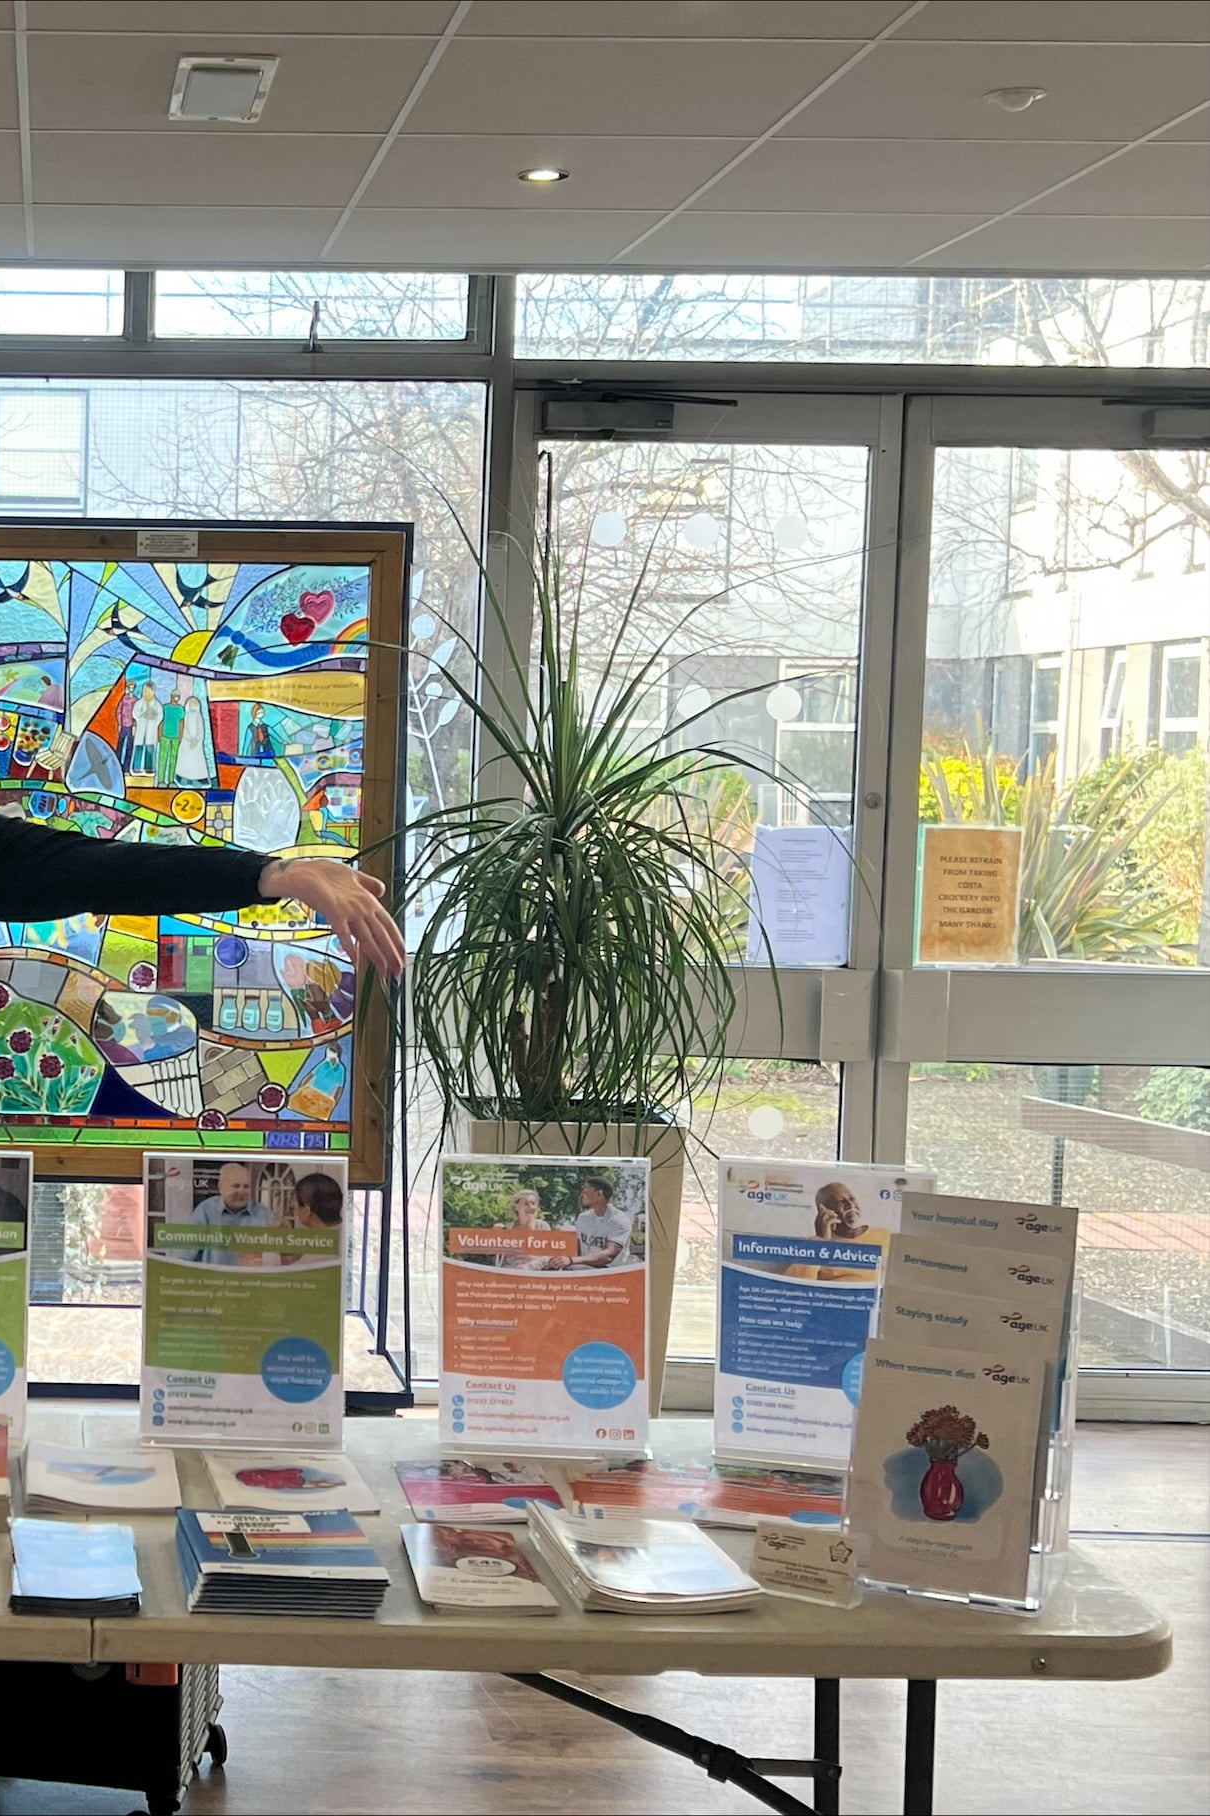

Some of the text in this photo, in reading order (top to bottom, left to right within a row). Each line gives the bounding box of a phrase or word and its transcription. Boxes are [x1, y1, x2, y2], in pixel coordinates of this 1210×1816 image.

[939, 856, 1003, 864] PLEASE REFRAIN
[943, 868, 998, 877] FROM TAKING
[966, 921, 997, 929] THANKS
[270, 1133, 324, 1147] NHS 75
[193, 1179, 209, 1188] UK
[747, 1190, 773, 1203] age
[911, 1210, 999, 1231] Your hospital stay
[1025, 1222, 1063, 1234] age UK
[157, 1229, 334, 1248] Community Warden Service
[457, 1234, 523, 1248] Volunteer
[527, 1236, 548, 1249] for
[550, 1240, 567, 1249] us
[738, 1240, 878, 1263] Information & Advice
[903, 1254, 968, 1273] Bereavement
[895, 1305, 968, 1327] Staying steady
[875, 1358, 976, 1380] When someone dies
[465, 1380, 517, 1391] Contact Us
[992, 1373, 1031, 1386] age UK
